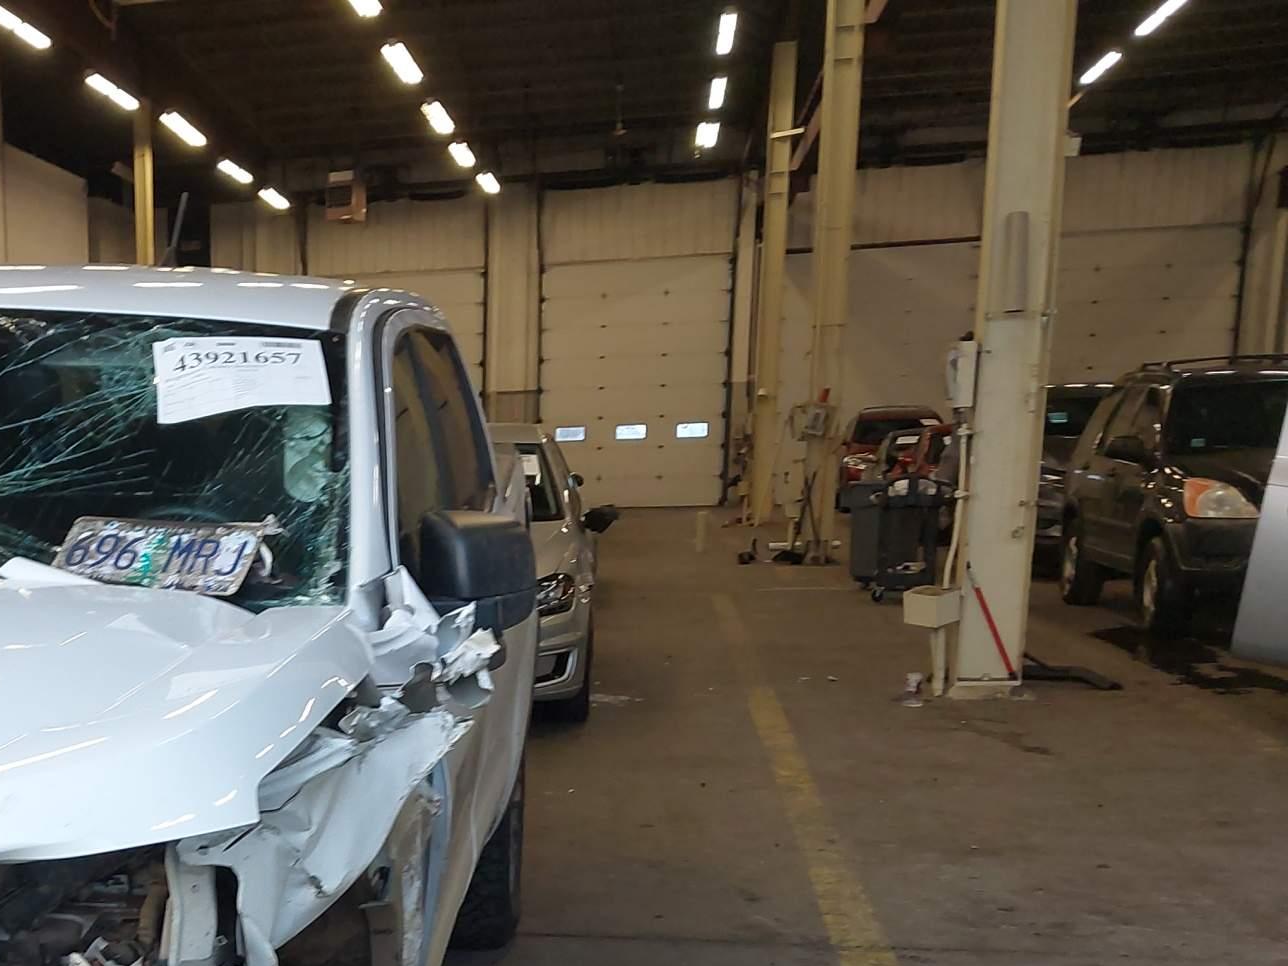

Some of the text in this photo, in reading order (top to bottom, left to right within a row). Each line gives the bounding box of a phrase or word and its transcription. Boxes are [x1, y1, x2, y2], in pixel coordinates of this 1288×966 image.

[173, 351, 302, 372] 43921657
[65, 533, 249, 577] 696 MRJ
